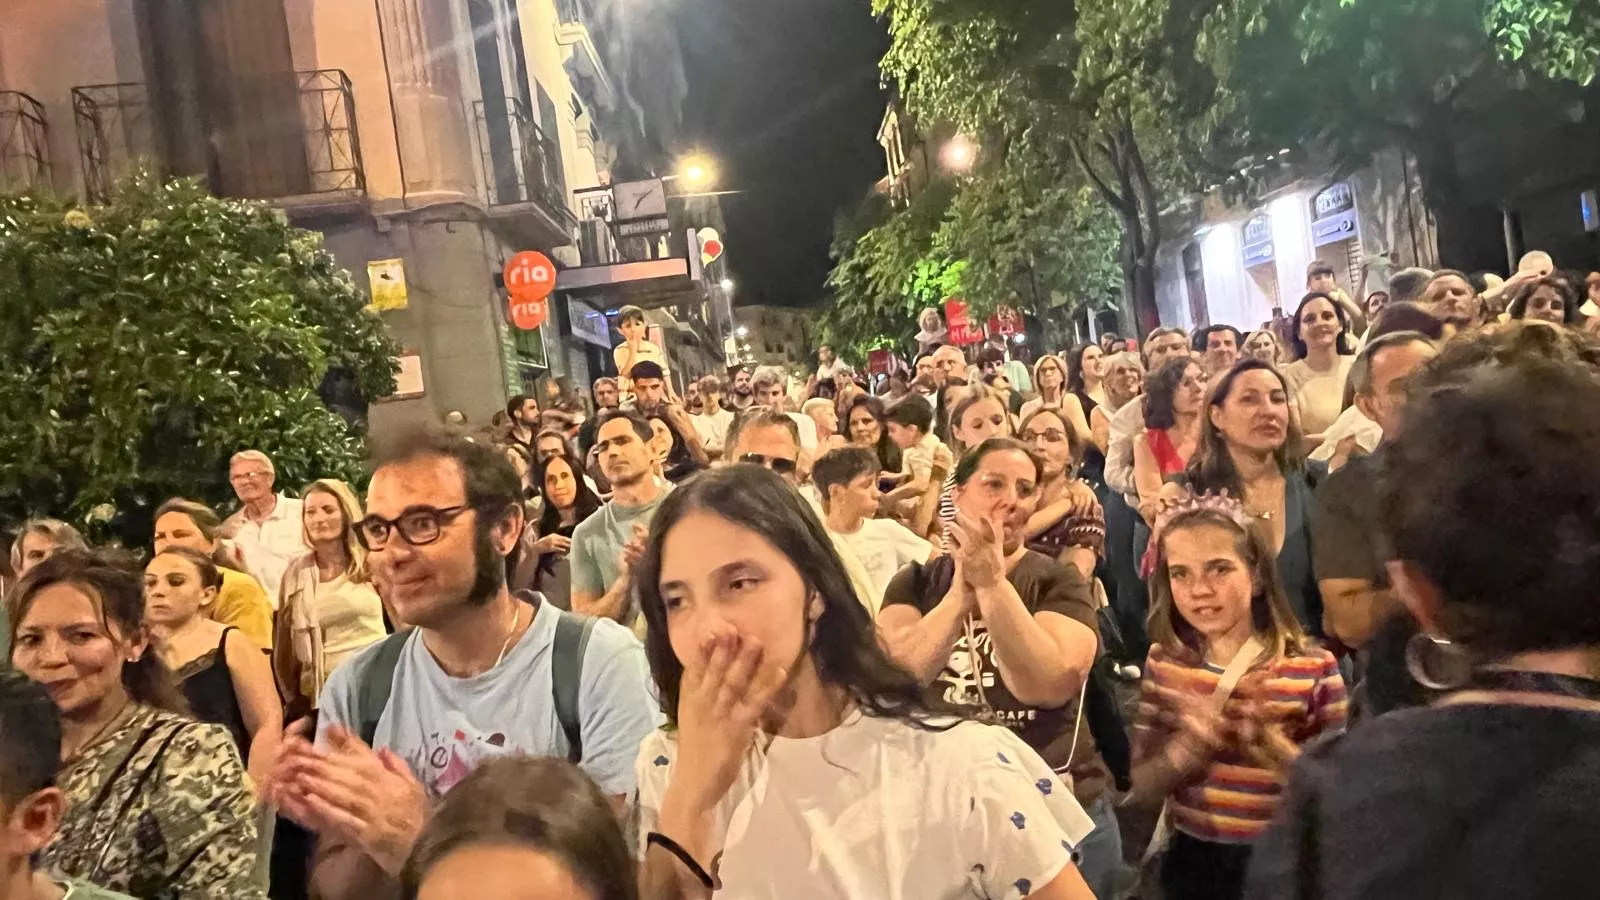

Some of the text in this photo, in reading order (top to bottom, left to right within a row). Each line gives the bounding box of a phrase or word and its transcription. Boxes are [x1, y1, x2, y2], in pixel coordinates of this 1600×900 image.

[510, 258, 548, 284] ria
[512, 303, 541, 318] ria
[996, 710, 1036, 720] CAFE
